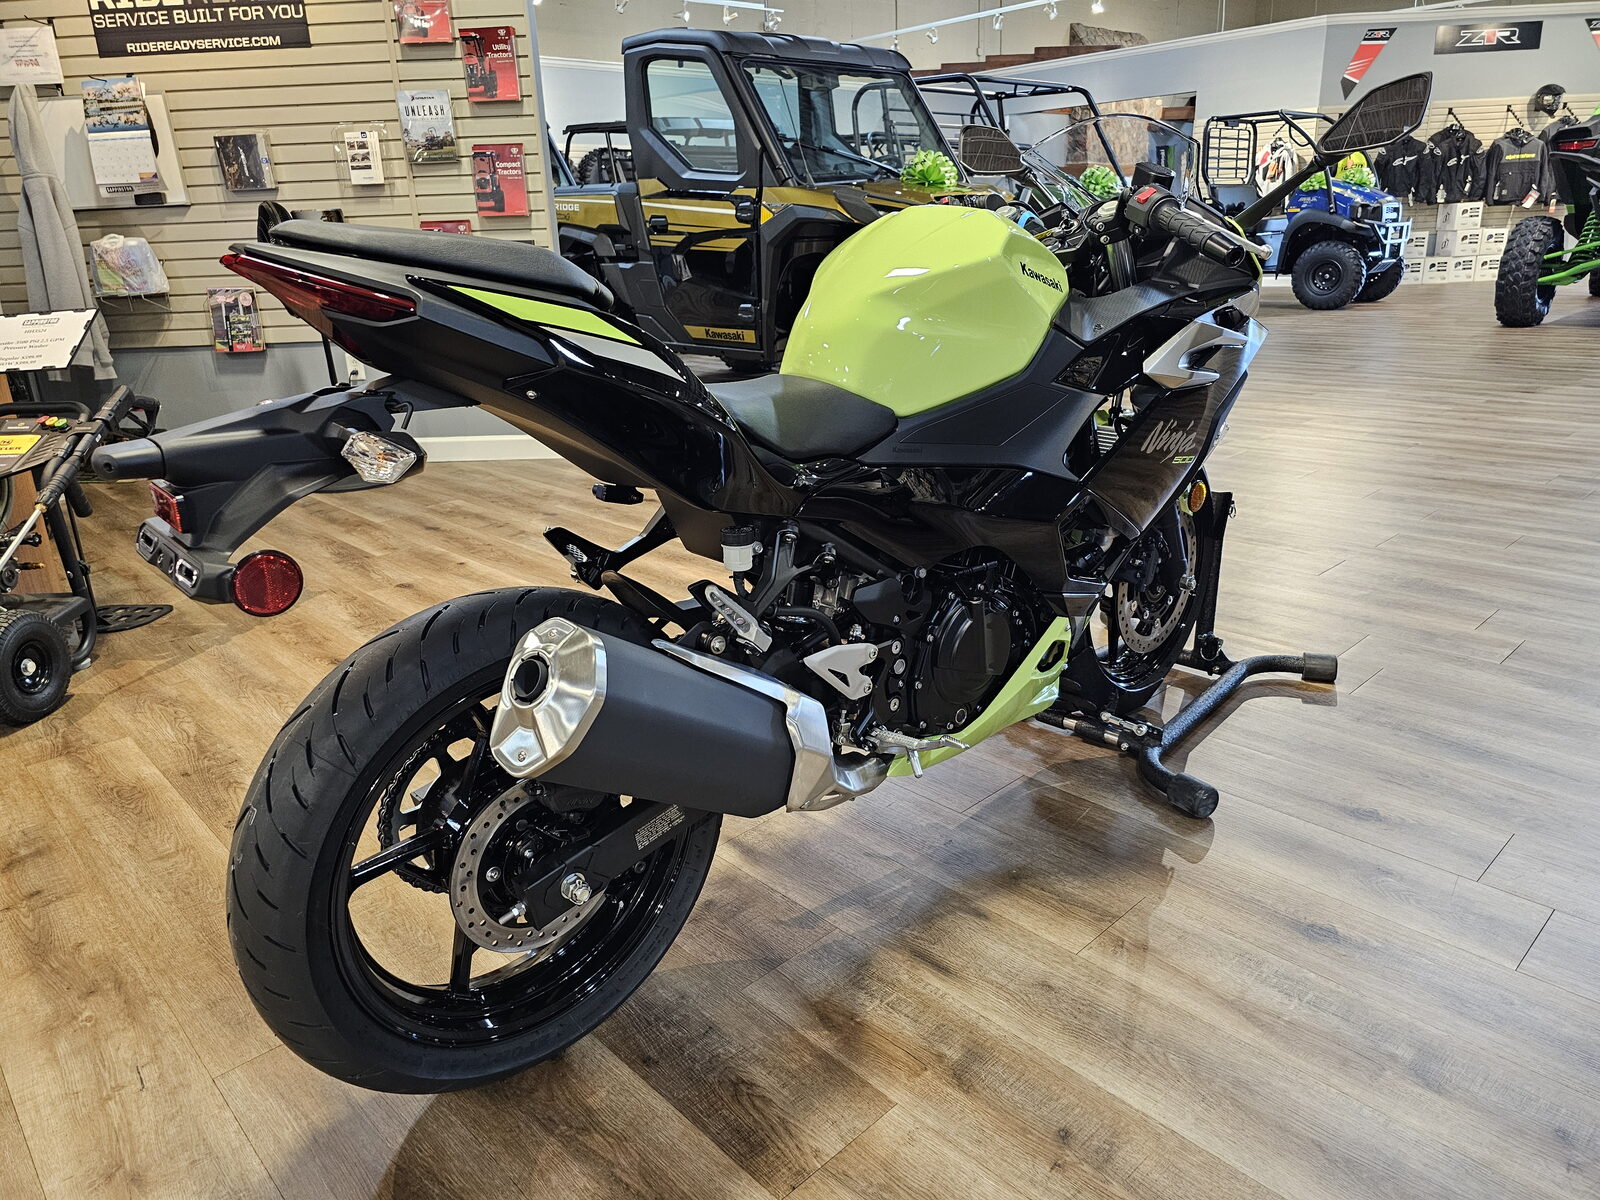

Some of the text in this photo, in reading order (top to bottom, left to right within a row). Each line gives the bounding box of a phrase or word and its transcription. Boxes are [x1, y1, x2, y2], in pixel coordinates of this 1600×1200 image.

[93, 4, 304, 29] SERVICE BUILT FOR YOU
[126, 35, 281, 53] RIDEREADYSERVICE.COM
[492, 43, 511, 51] Utility
[404, 105, 445, 117] UNLEASH
[554, 203, 580, 212] RIDGE
[1020, 261, 1063, 293] Kawasaki
[705, 328, 744, 341] Kawasaki
[1140, 419, 1196, 464] Ninja
[1171, 456, 1196, 464] 500
